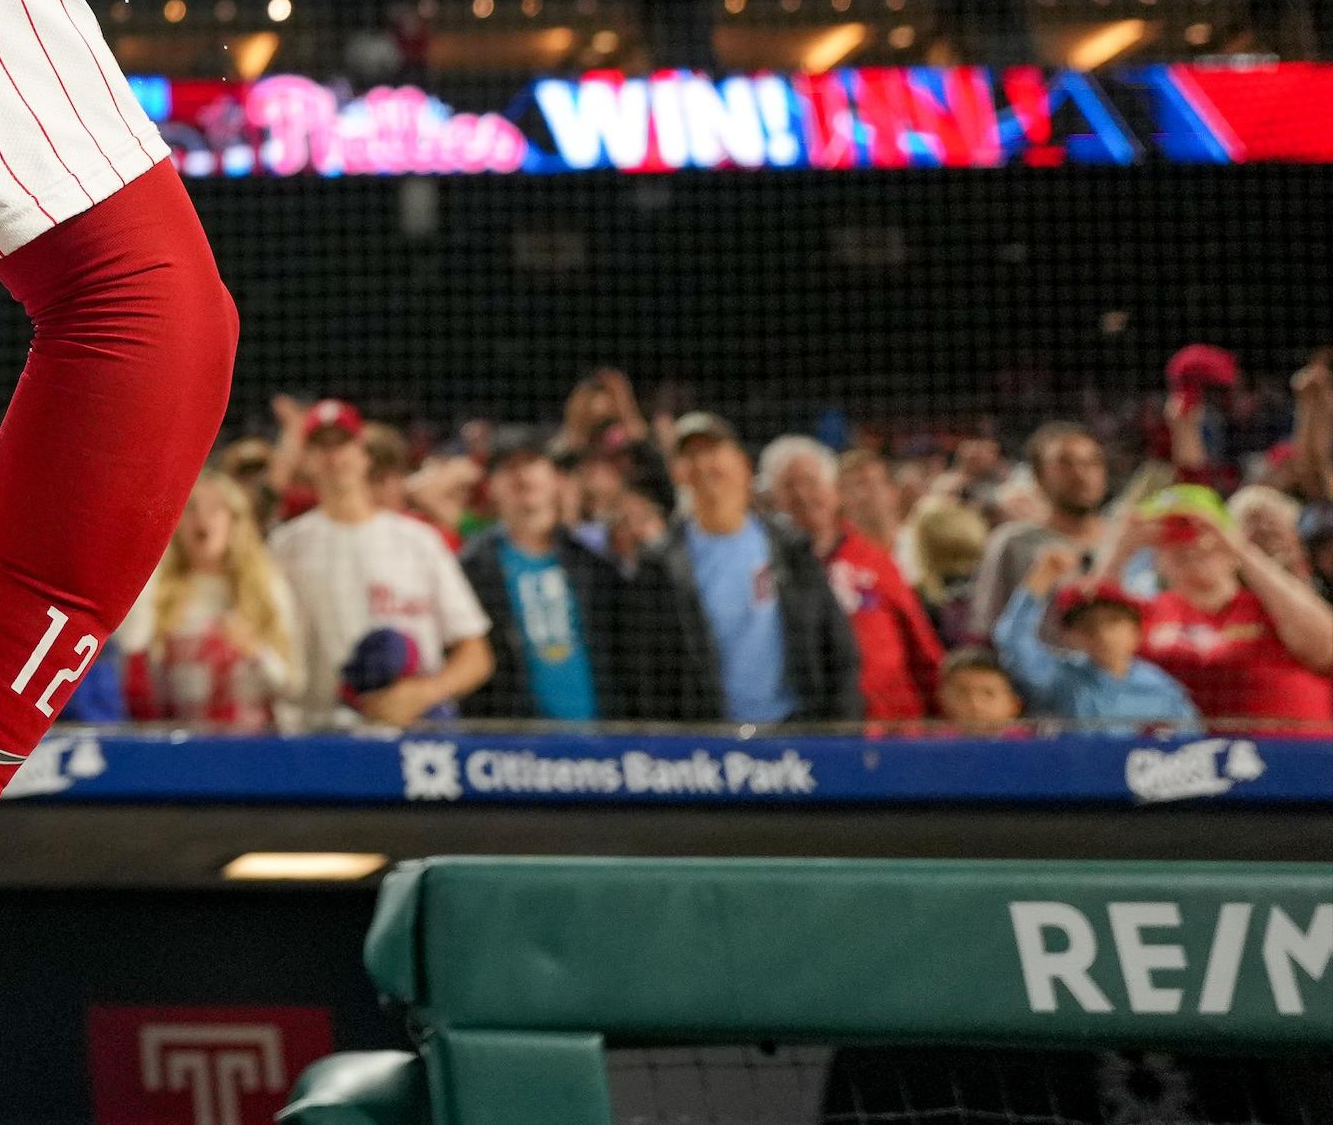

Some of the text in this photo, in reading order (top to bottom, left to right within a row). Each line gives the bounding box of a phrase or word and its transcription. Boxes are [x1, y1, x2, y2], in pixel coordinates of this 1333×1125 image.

[535, 74, 800, 169] WIN!
[10, 605, 99, 719] 12
[465, 749, 816, 794] Citizens Bank Park
[1008, 901, 1333, 1015] RE/M
